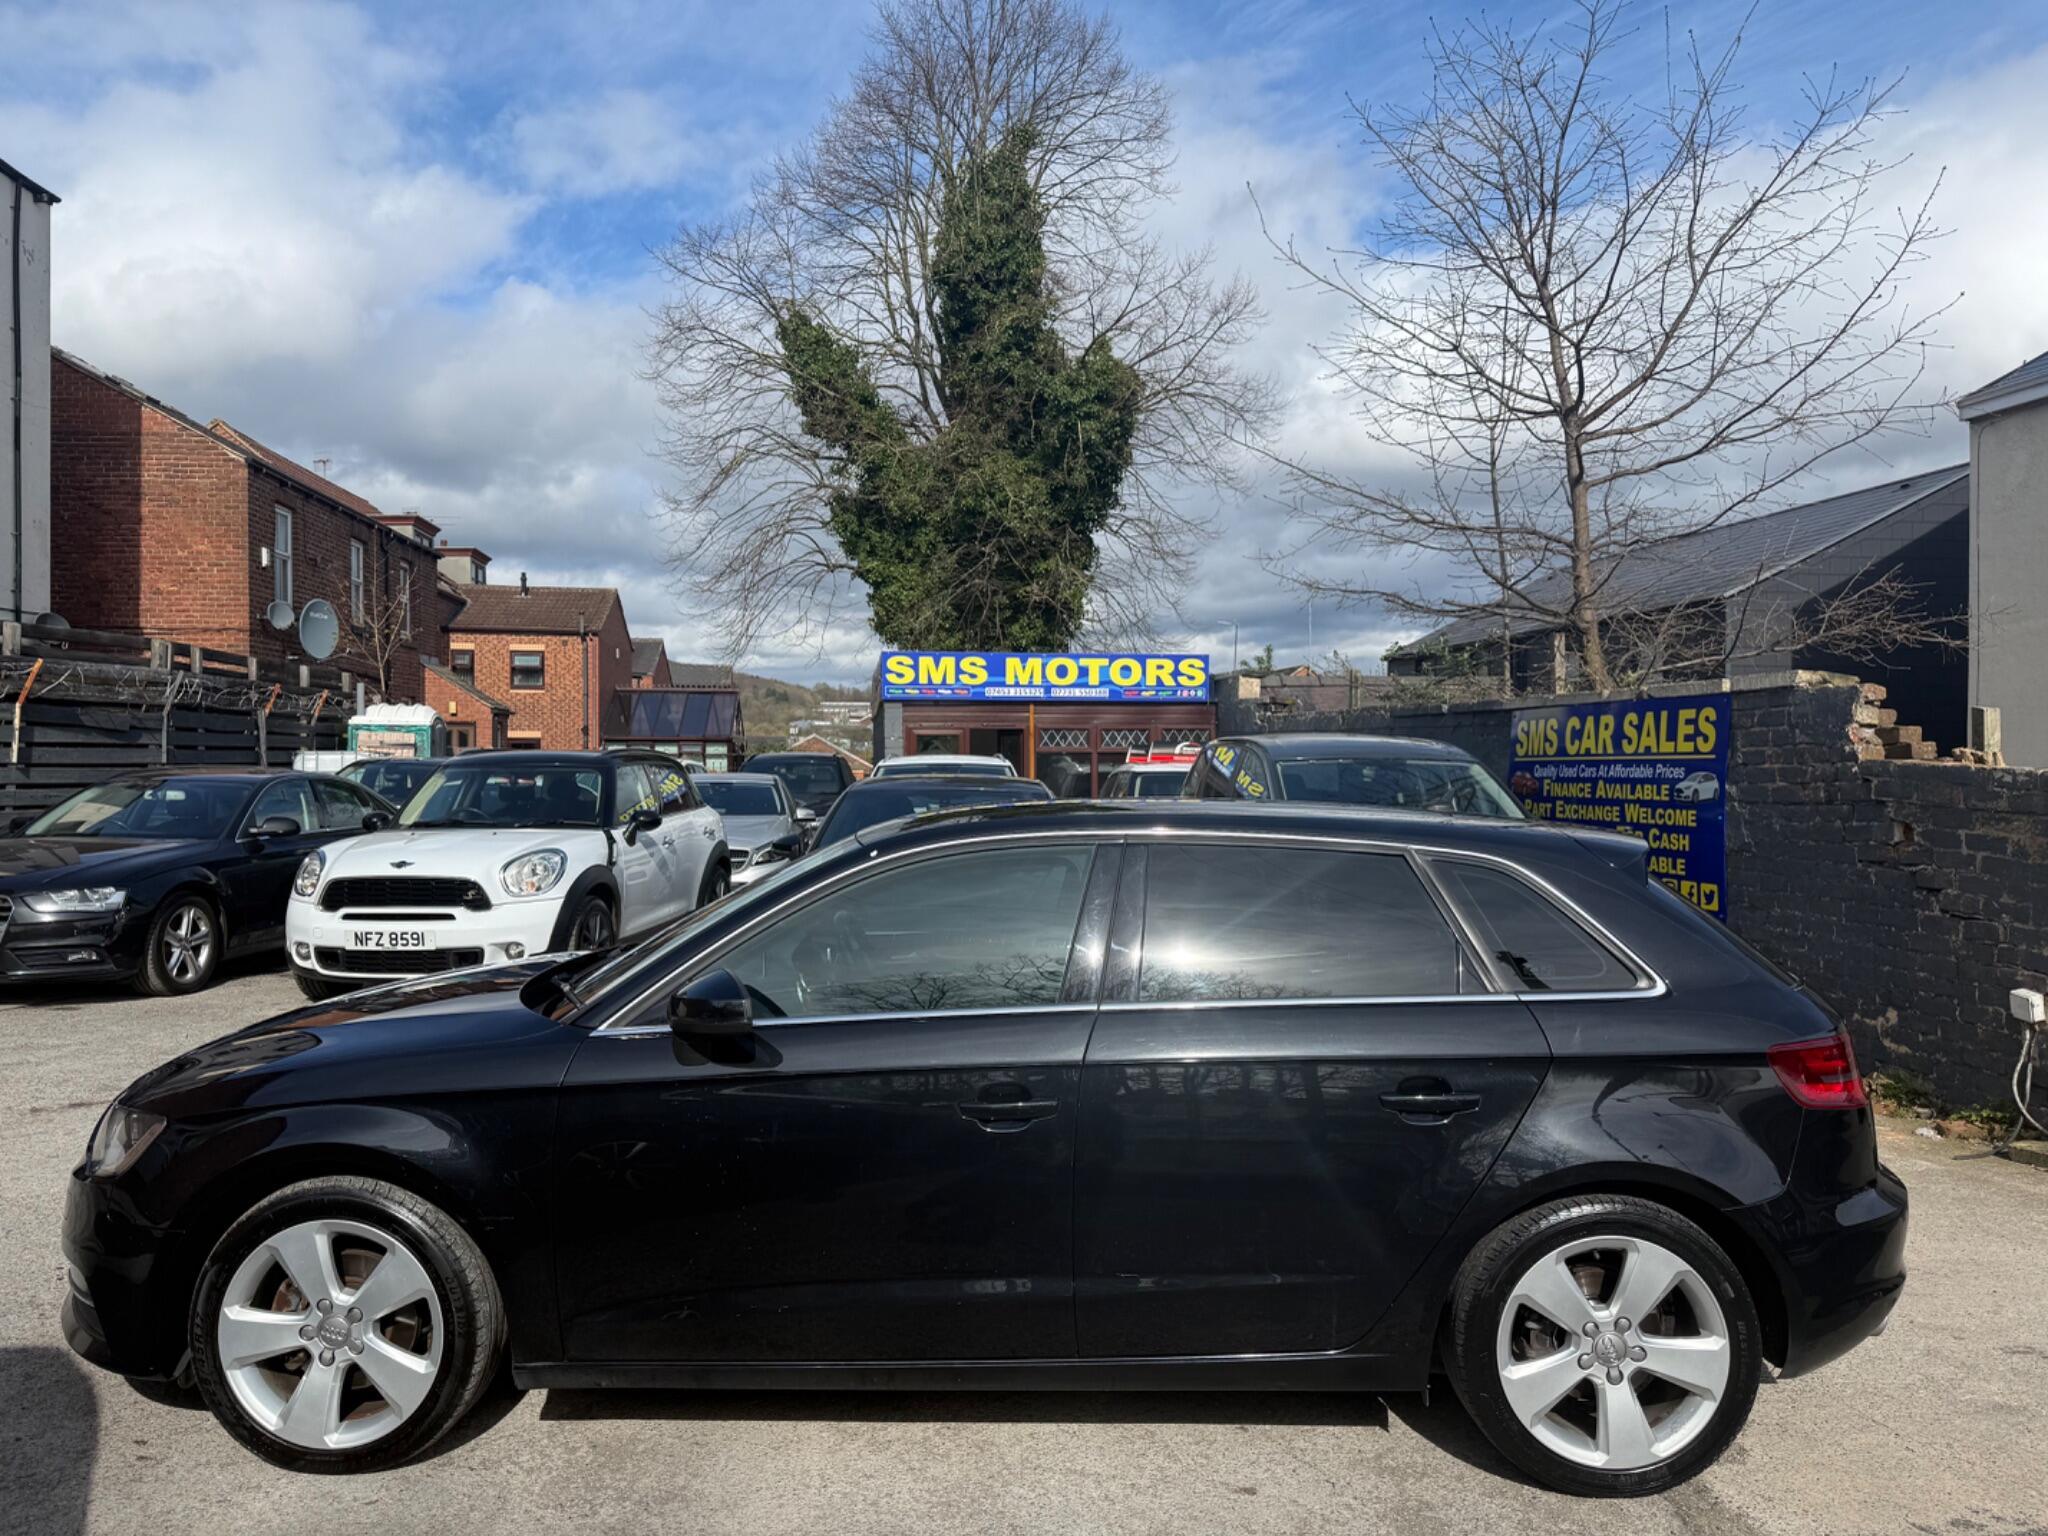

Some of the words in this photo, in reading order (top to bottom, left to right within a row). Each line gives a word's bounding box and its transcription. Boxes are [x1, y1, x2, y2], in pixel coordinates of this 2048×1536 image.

[885, 655, 989, 685] SMS
[1005, 657, 1206, 687] MOTORS
[1515, 718, 1558, 756] SMS
[1565, 714, 1615, 755] CAR
[1621, 707, 1717, 754] SALES
[1534, 764, 1558, 779] Quality
[1559, 765, 1577, 777] Used
[1578, 765, 1596, 777] Cars
[1599, 764, 1608, 777] At
[1608, 764, 1653, 778] Affordable
[1655, 763, 1686, 779] Prices
[1543, 779, 1592, 798] FINANCE
[1595, 779, 1670, 801] AVAILABLE
[1555, 800, 1620, 822] EXCHANGE
[1624, 803, 1697, 827] WELCOME
[1648, 828, 1690, 852] CASH
[353, 931, 385, 947] NFZ
[388, 931, 426, 947] 8591
